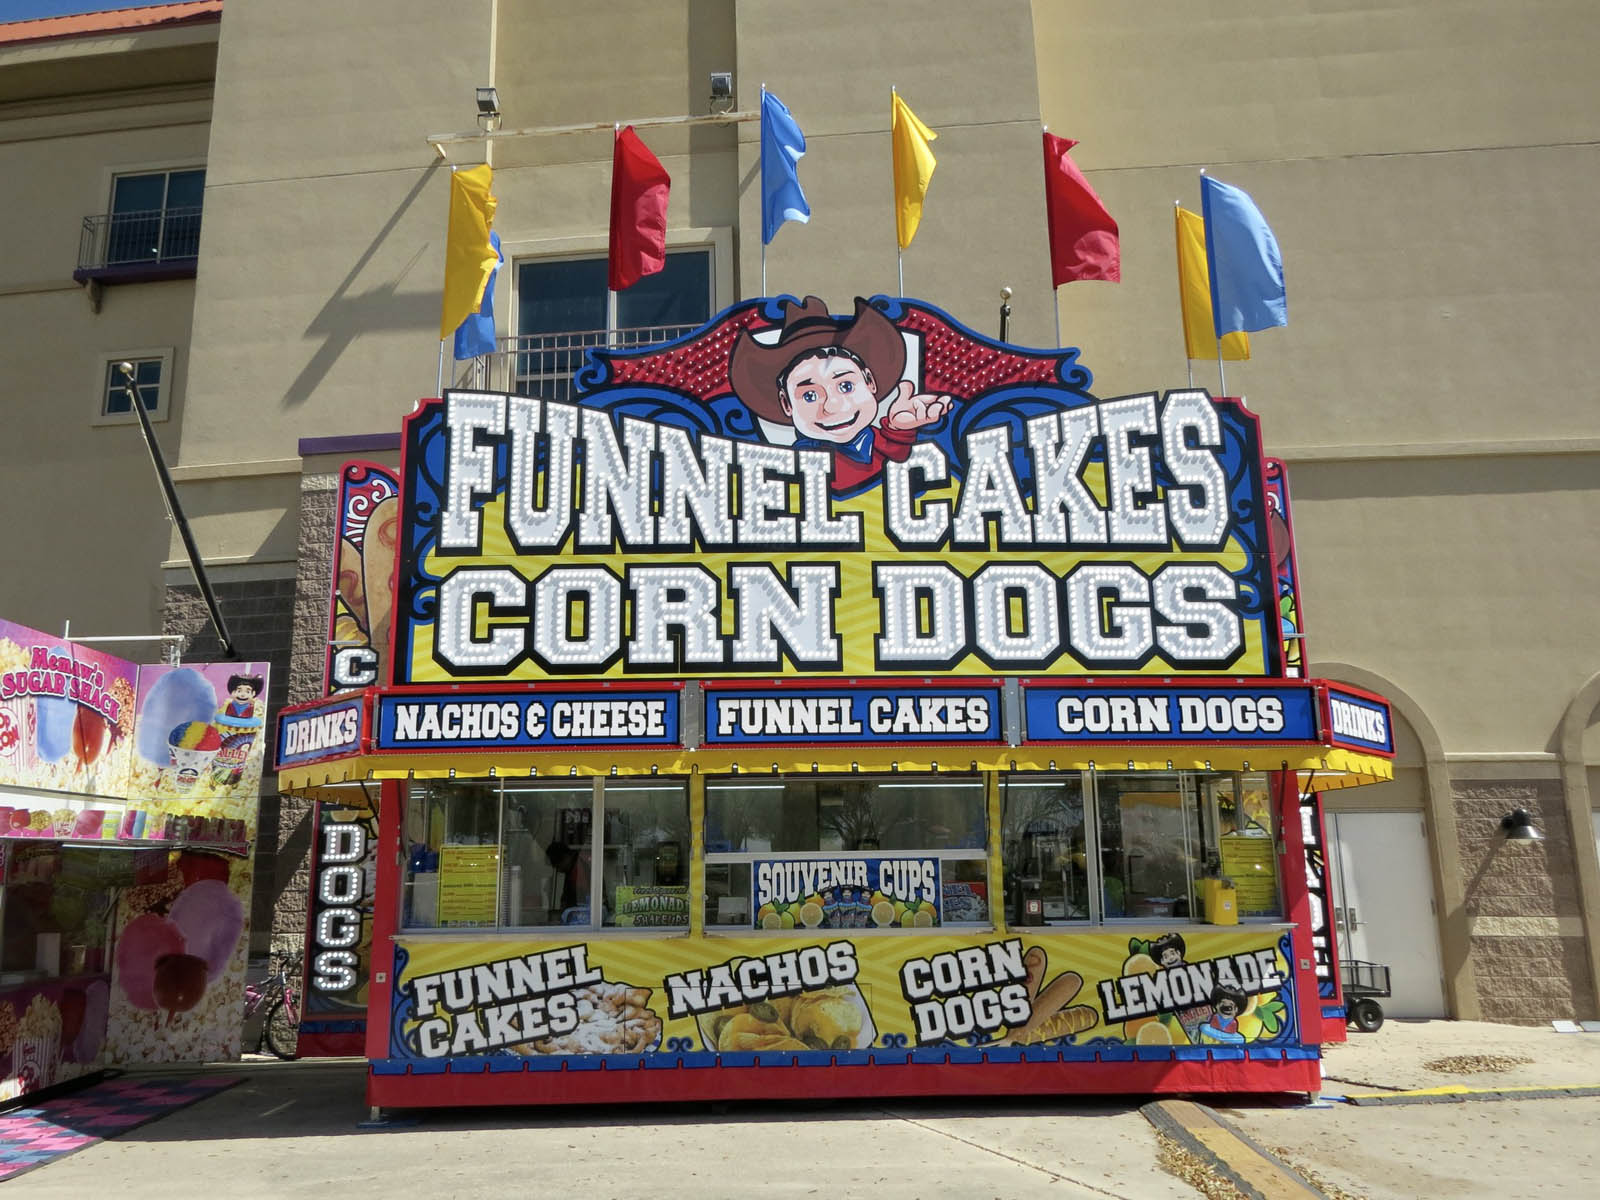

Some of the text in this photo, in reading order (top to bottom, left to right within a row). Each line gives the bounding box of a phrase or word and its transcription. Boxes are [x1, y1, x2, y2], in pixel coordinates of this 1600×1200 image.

[439, 390, 1230, 549] FUNNEL CAKES
[437, 564, 1242, 664] CORN DOGS
[1, 671, 121, 724] SUGAR SHACK
[395, 700, 665, 740] NACHOS & CHEESE
[717, 697, 990, 735] FUNNEL CAKES
[1057, 697, 1285, 732] CORN DOGS
[1330, 698, 1386, 744] DRINKS
[284, 707, 359, 757] DRINKS
[313, 823, 368, 992] DOGS
[757, 859, 936, 906] SOUVENIR CUPS
[412, 946, 601, 1016] FUNNEL
[667, 940, 859, 1015] NACHOS
[903, 940, 1028, 999] CORN
[1102, 947, 1285, 1021] LEMONADE
[417, 992, 580, 1058] CAKES
[915, 985, 1031, 1043] DOGS
